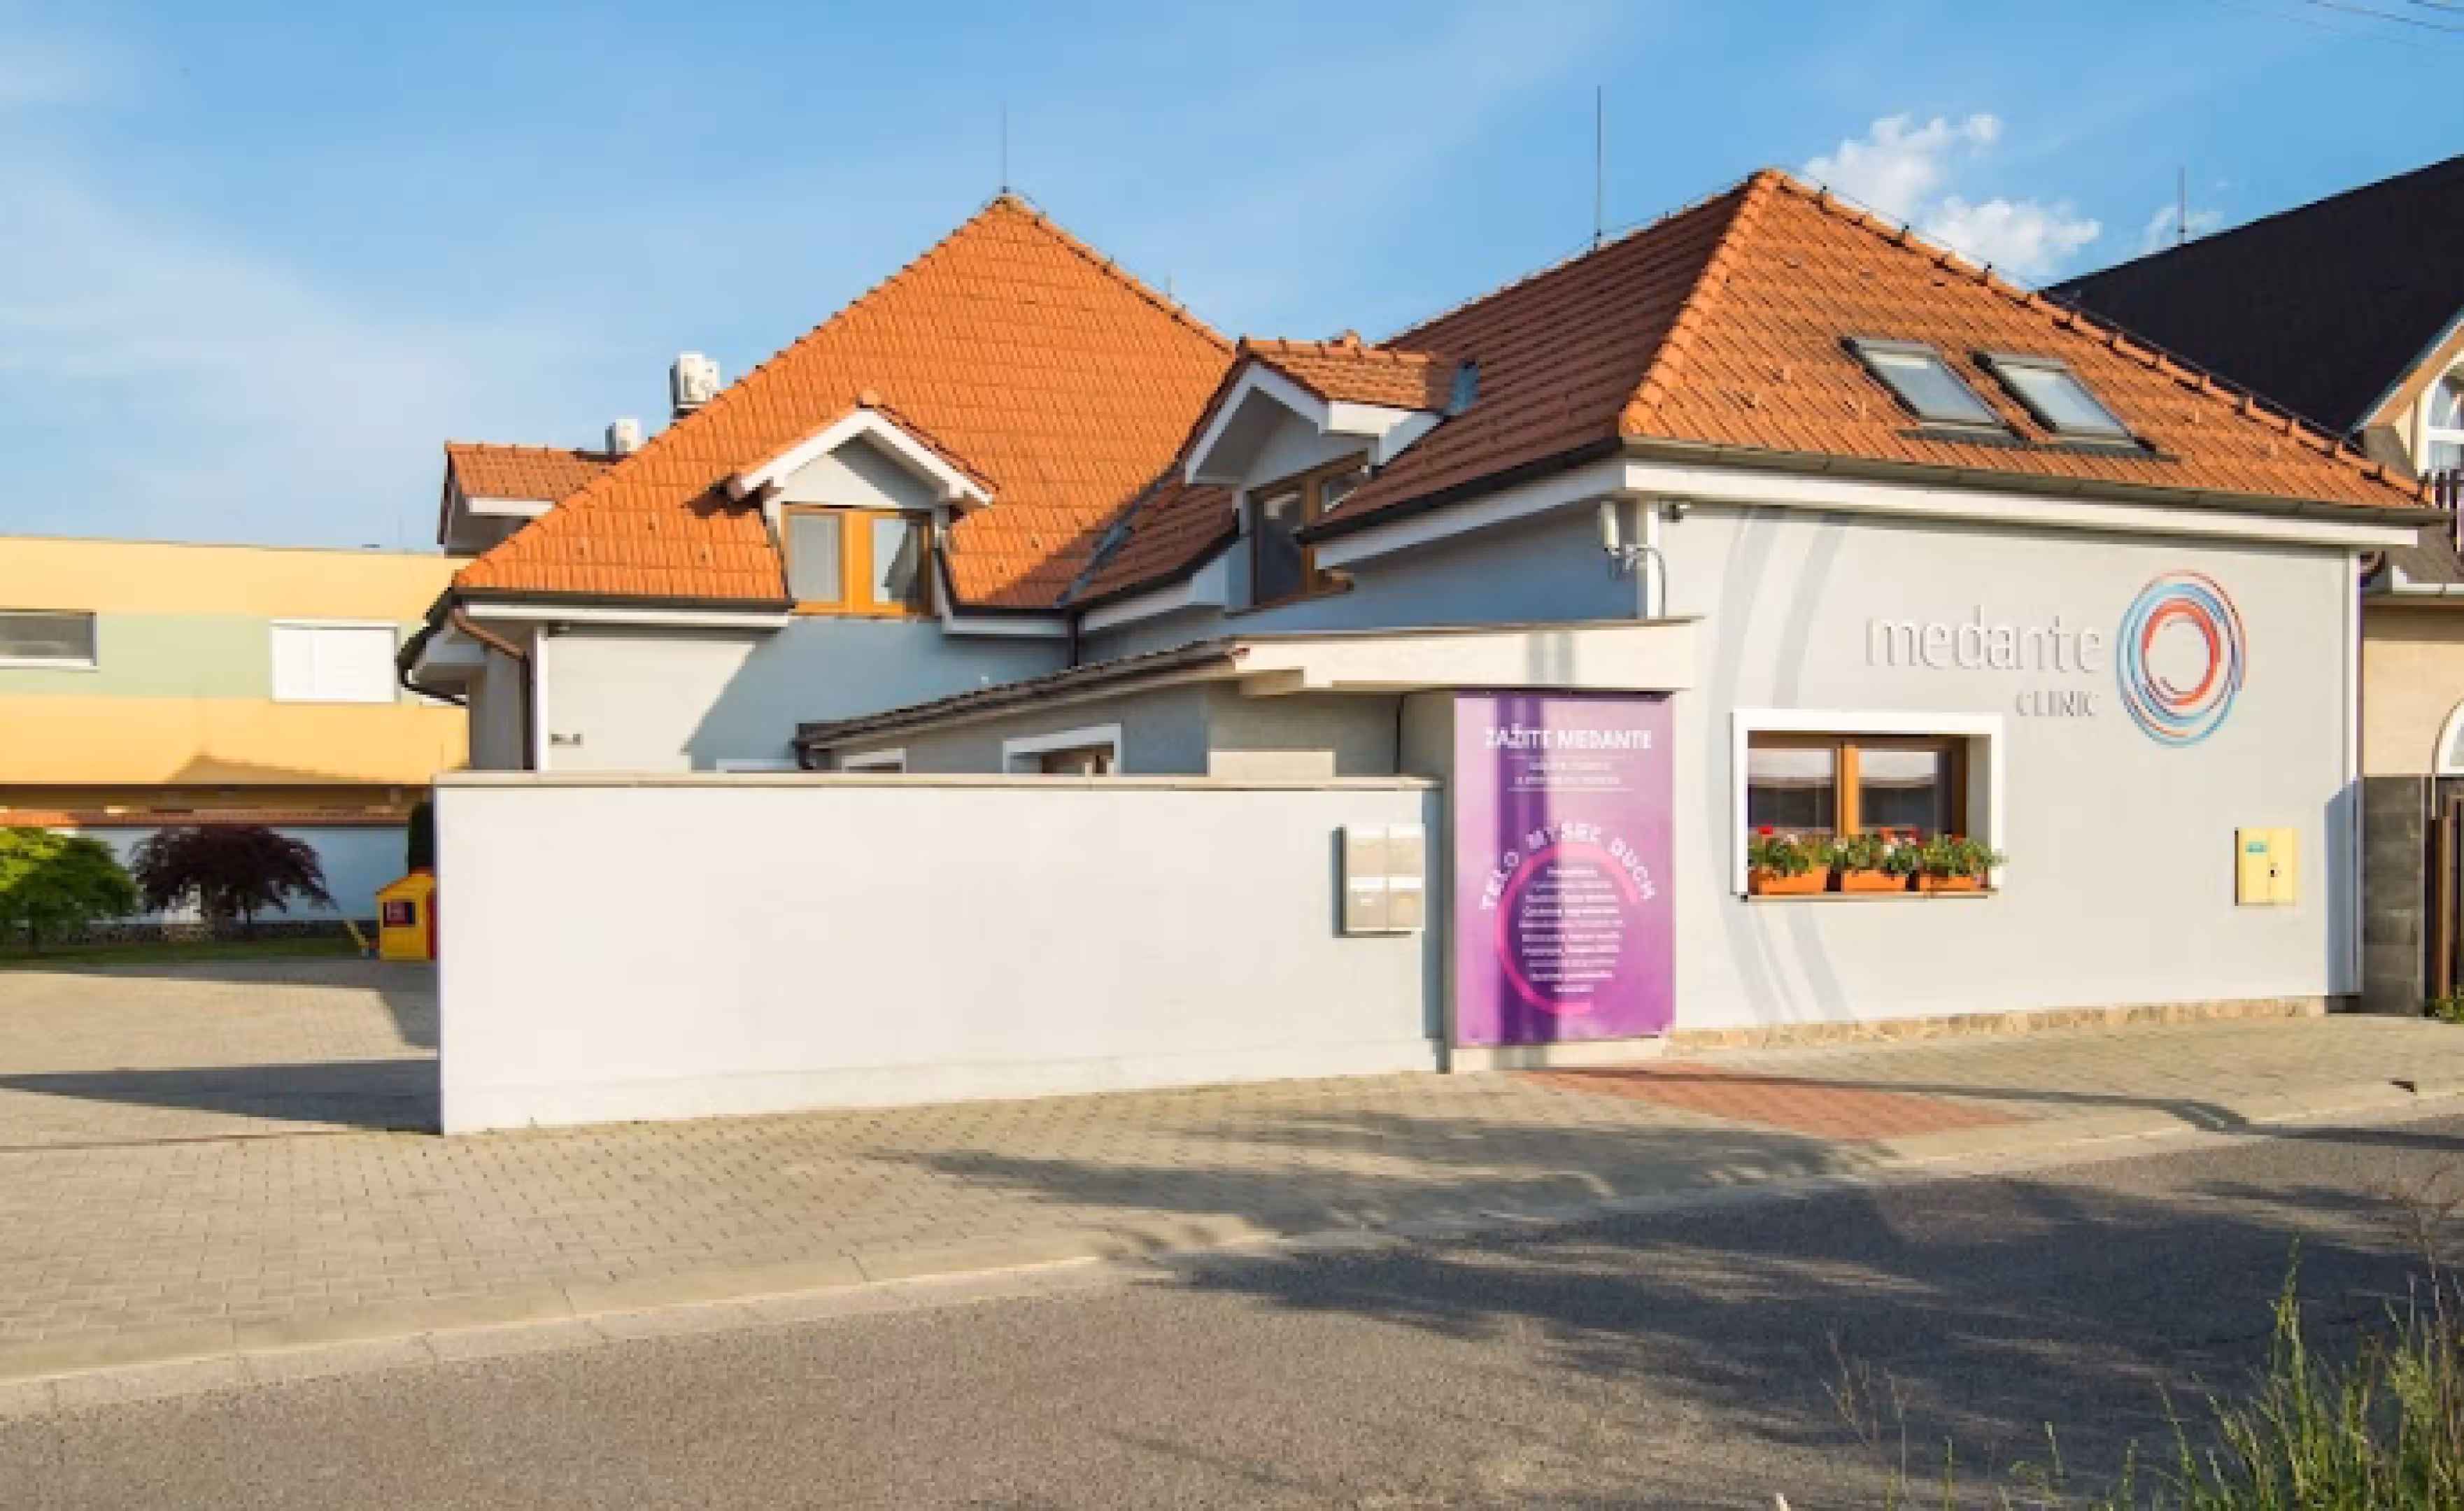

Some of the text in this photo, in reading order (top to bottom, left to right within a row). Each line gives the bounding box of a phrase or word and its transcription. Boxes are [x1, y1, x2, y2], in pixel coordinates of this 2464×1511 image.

[1865, 604, 2100, 673] medante
[2015, 690, 2100, 717] CLINIC
[1484, 723, 1652, 749] ZAŽITE MEDANTE
[1611, 839, 1655, 899] DUCH
